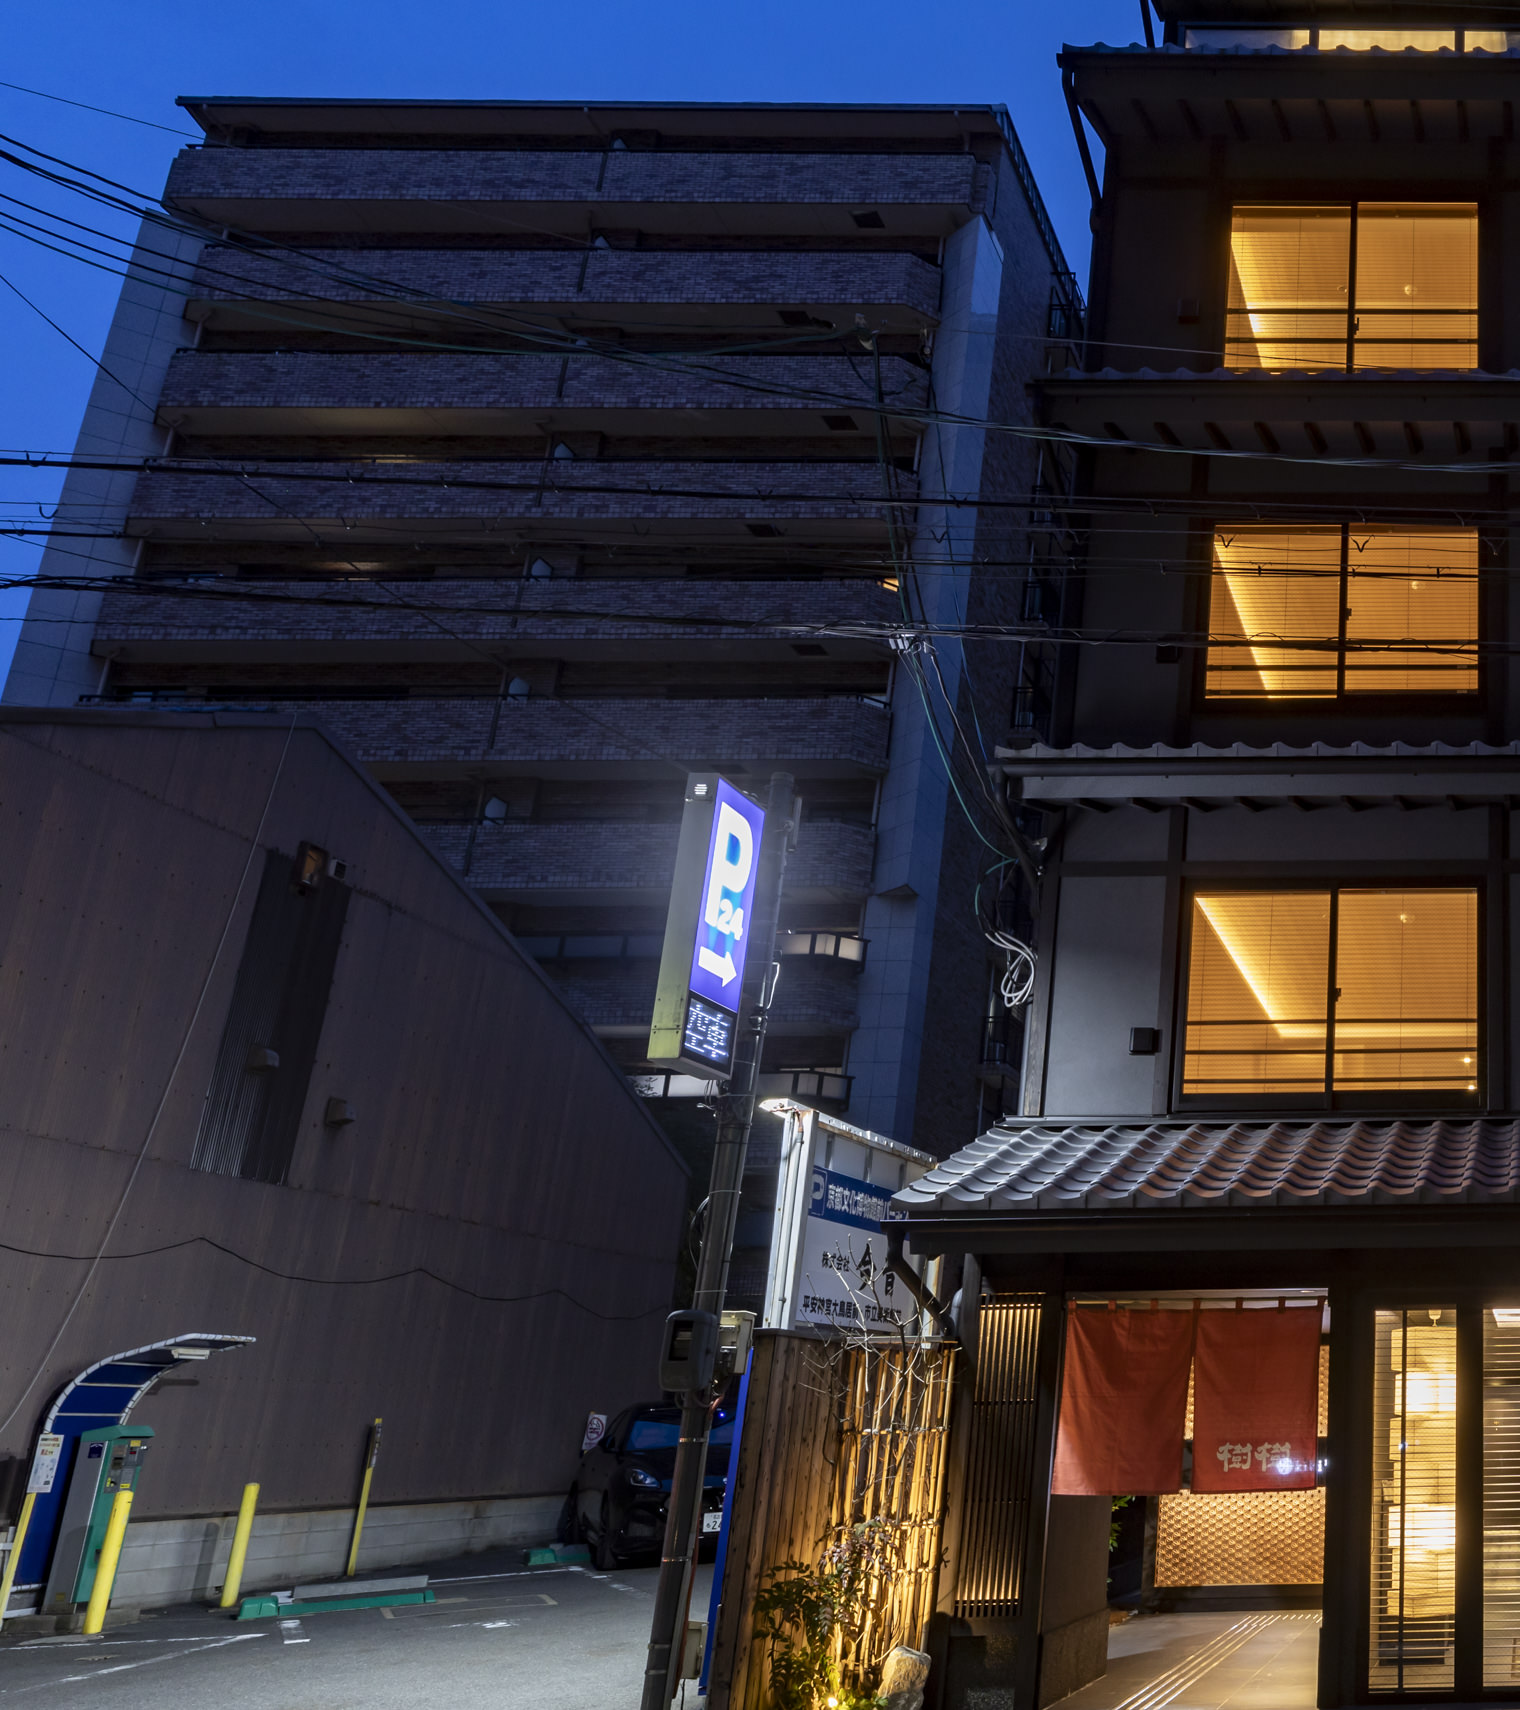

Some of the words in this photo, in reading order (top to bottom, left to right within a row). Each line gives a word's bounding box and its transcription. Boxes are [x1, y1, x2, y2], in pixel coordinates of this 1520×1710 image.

[705, 801, 753, 926] P
[717, 898, 744, 941] 24
[684, 1003, 729, 1057] 空車
